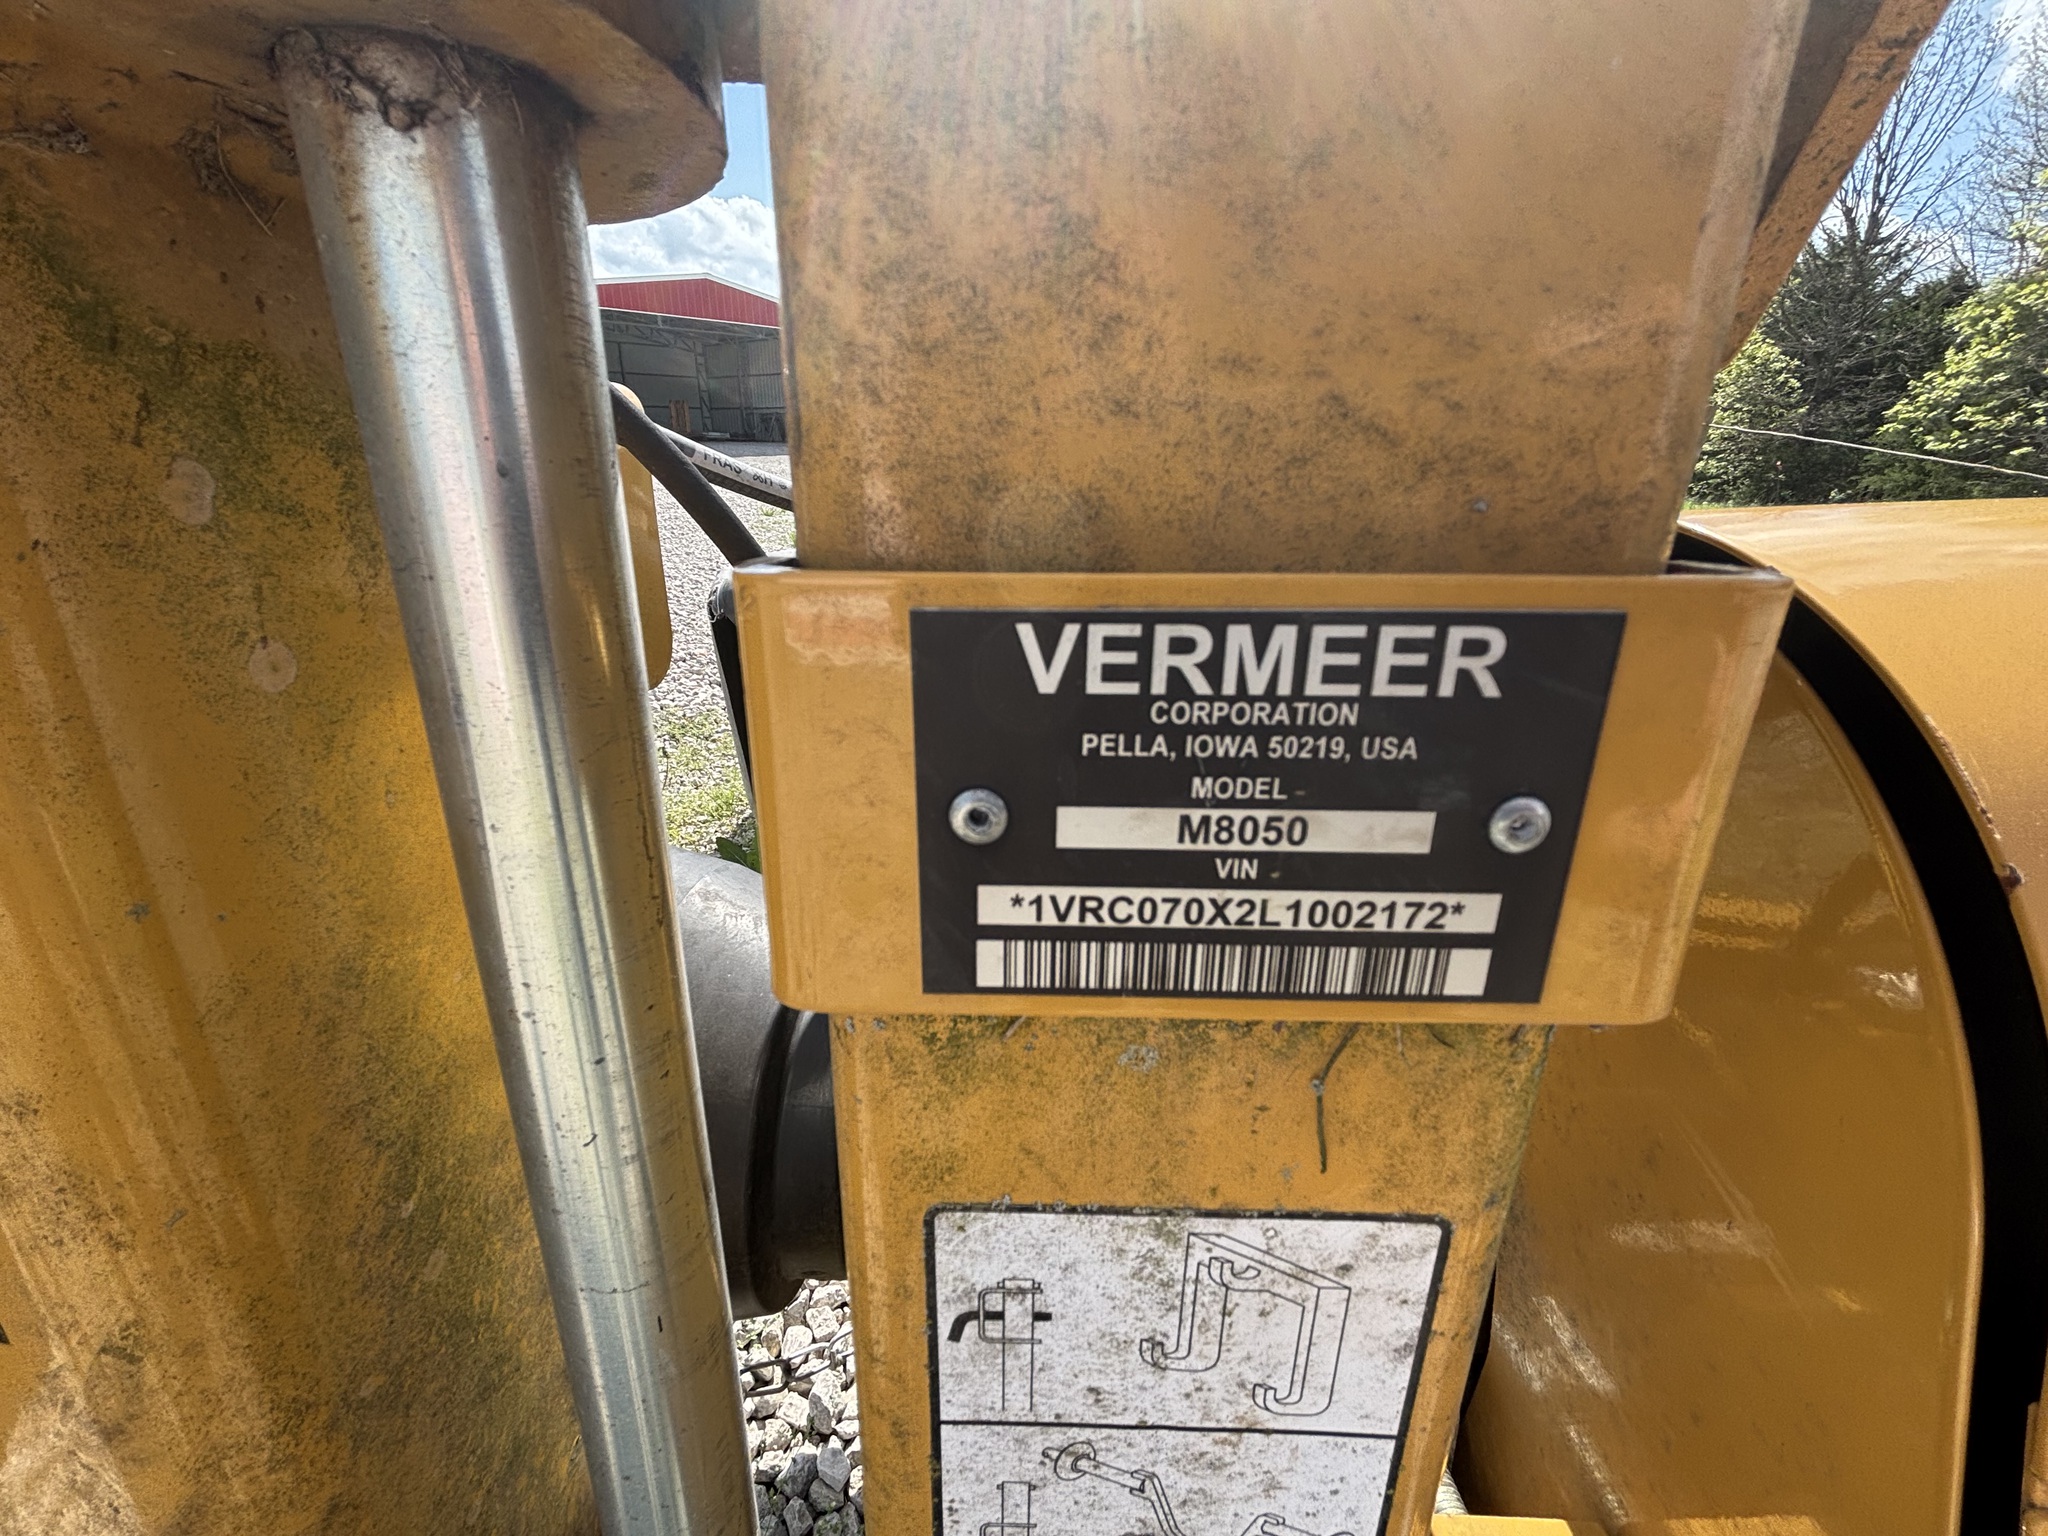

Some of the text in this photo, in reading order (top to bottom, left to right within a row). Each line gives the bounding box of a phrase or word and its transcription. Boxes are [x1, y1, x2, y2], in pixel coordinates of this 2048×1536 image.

[1014, 622, 1507, 699] VERMEER
[1150, 700, 1360, 727] CORPORATION
[1081, 733, 1418, 763] PELLA, IOWA 50219, USA
[1190, 776, 1288, 800] MODEL
[1178, 814, 1309, 846] M8050
[1214, 857, 1259, 880] VIN
